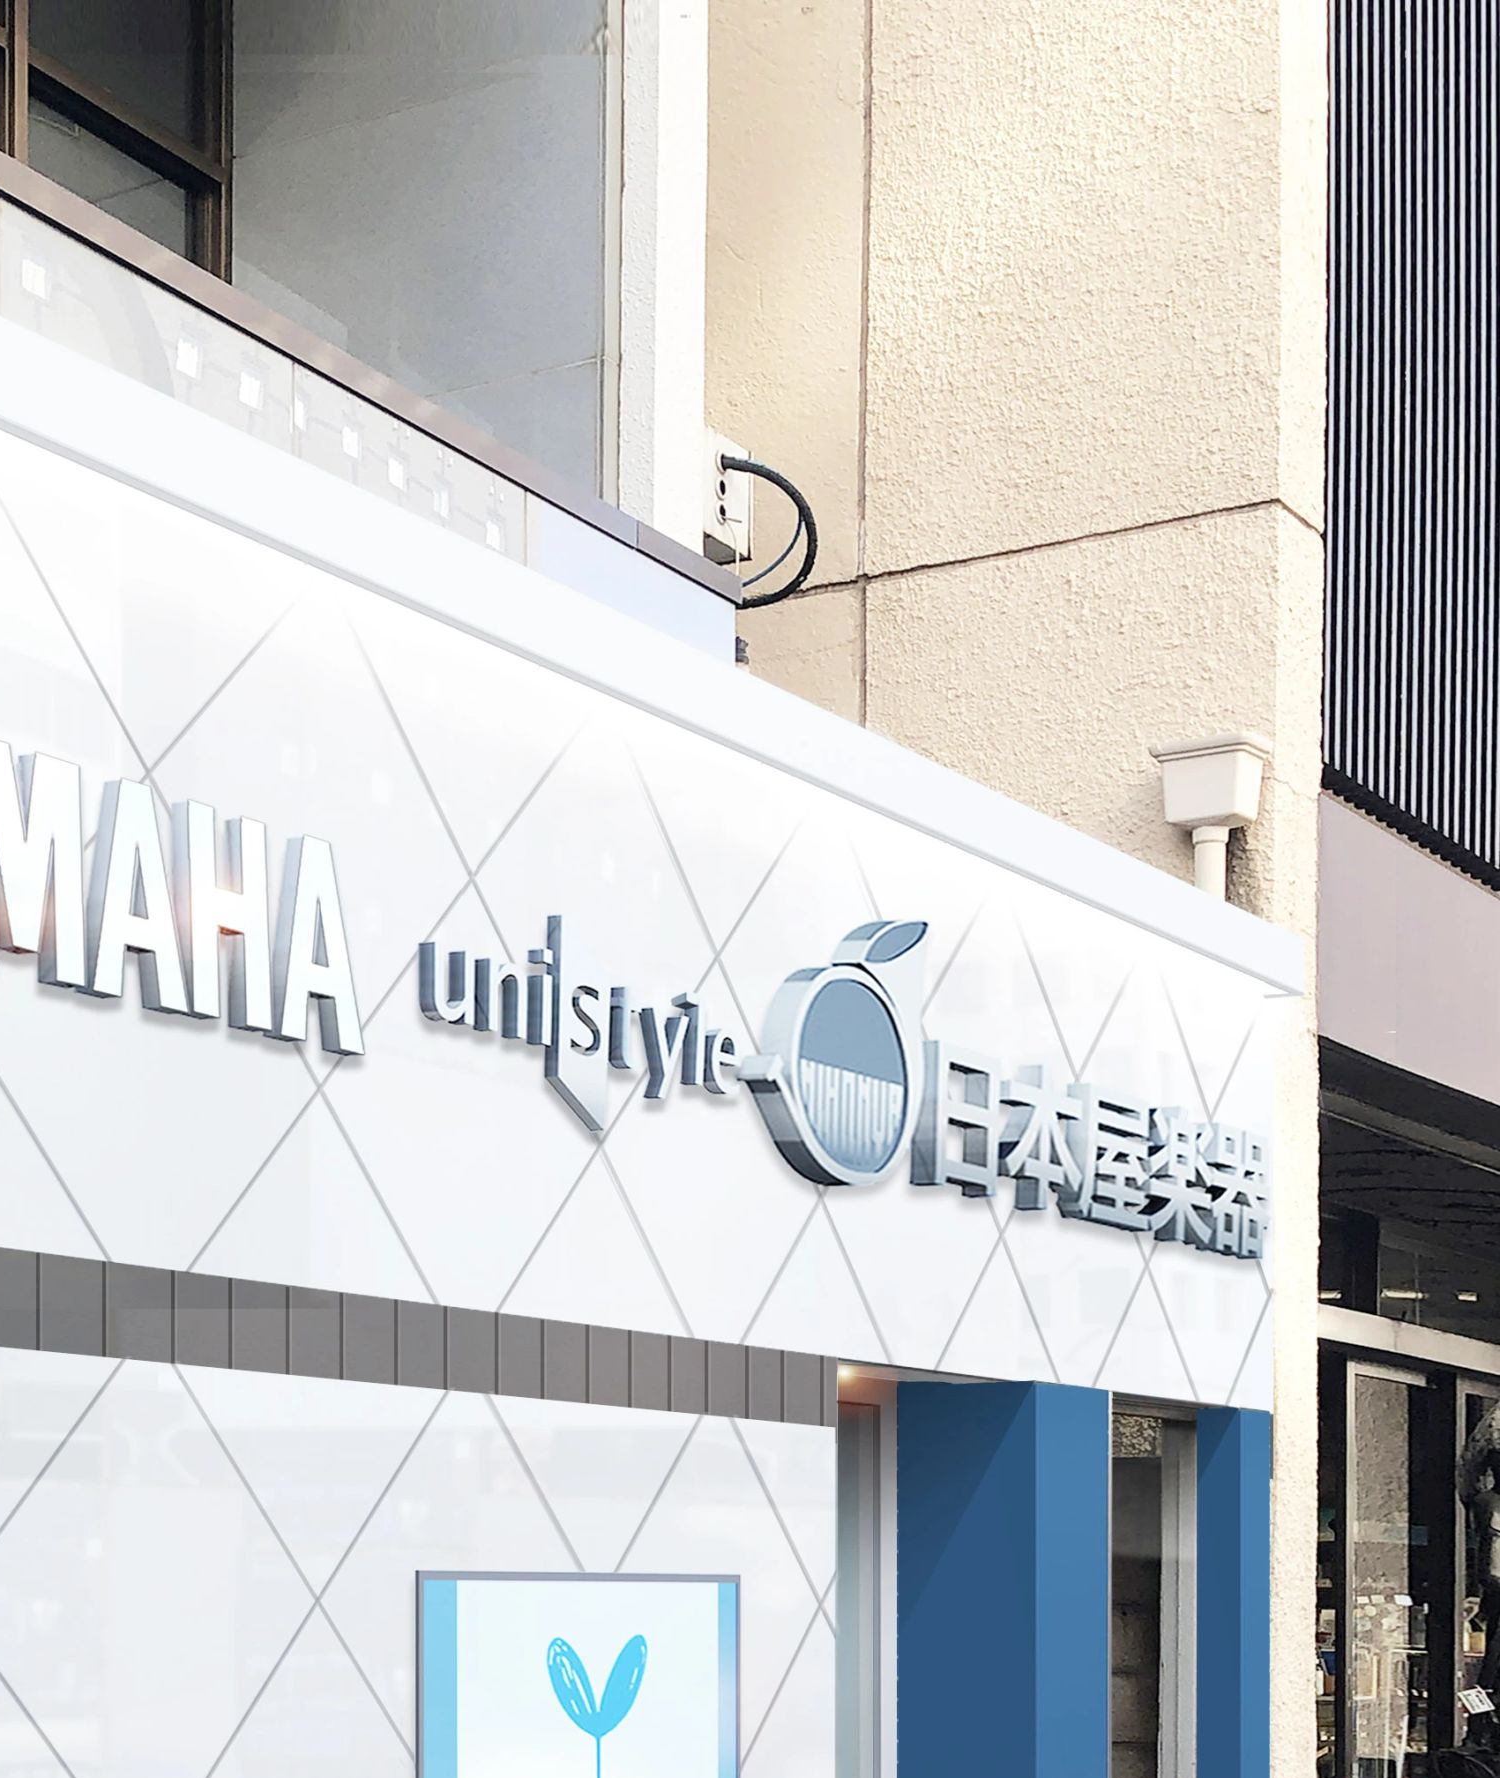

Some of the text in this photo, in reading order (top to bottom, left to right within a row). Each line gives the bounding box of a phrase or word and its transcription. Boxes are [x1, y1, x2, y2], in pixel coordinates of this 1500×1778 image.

[911, 1040, 1271, 1260] 日本屋楽器
